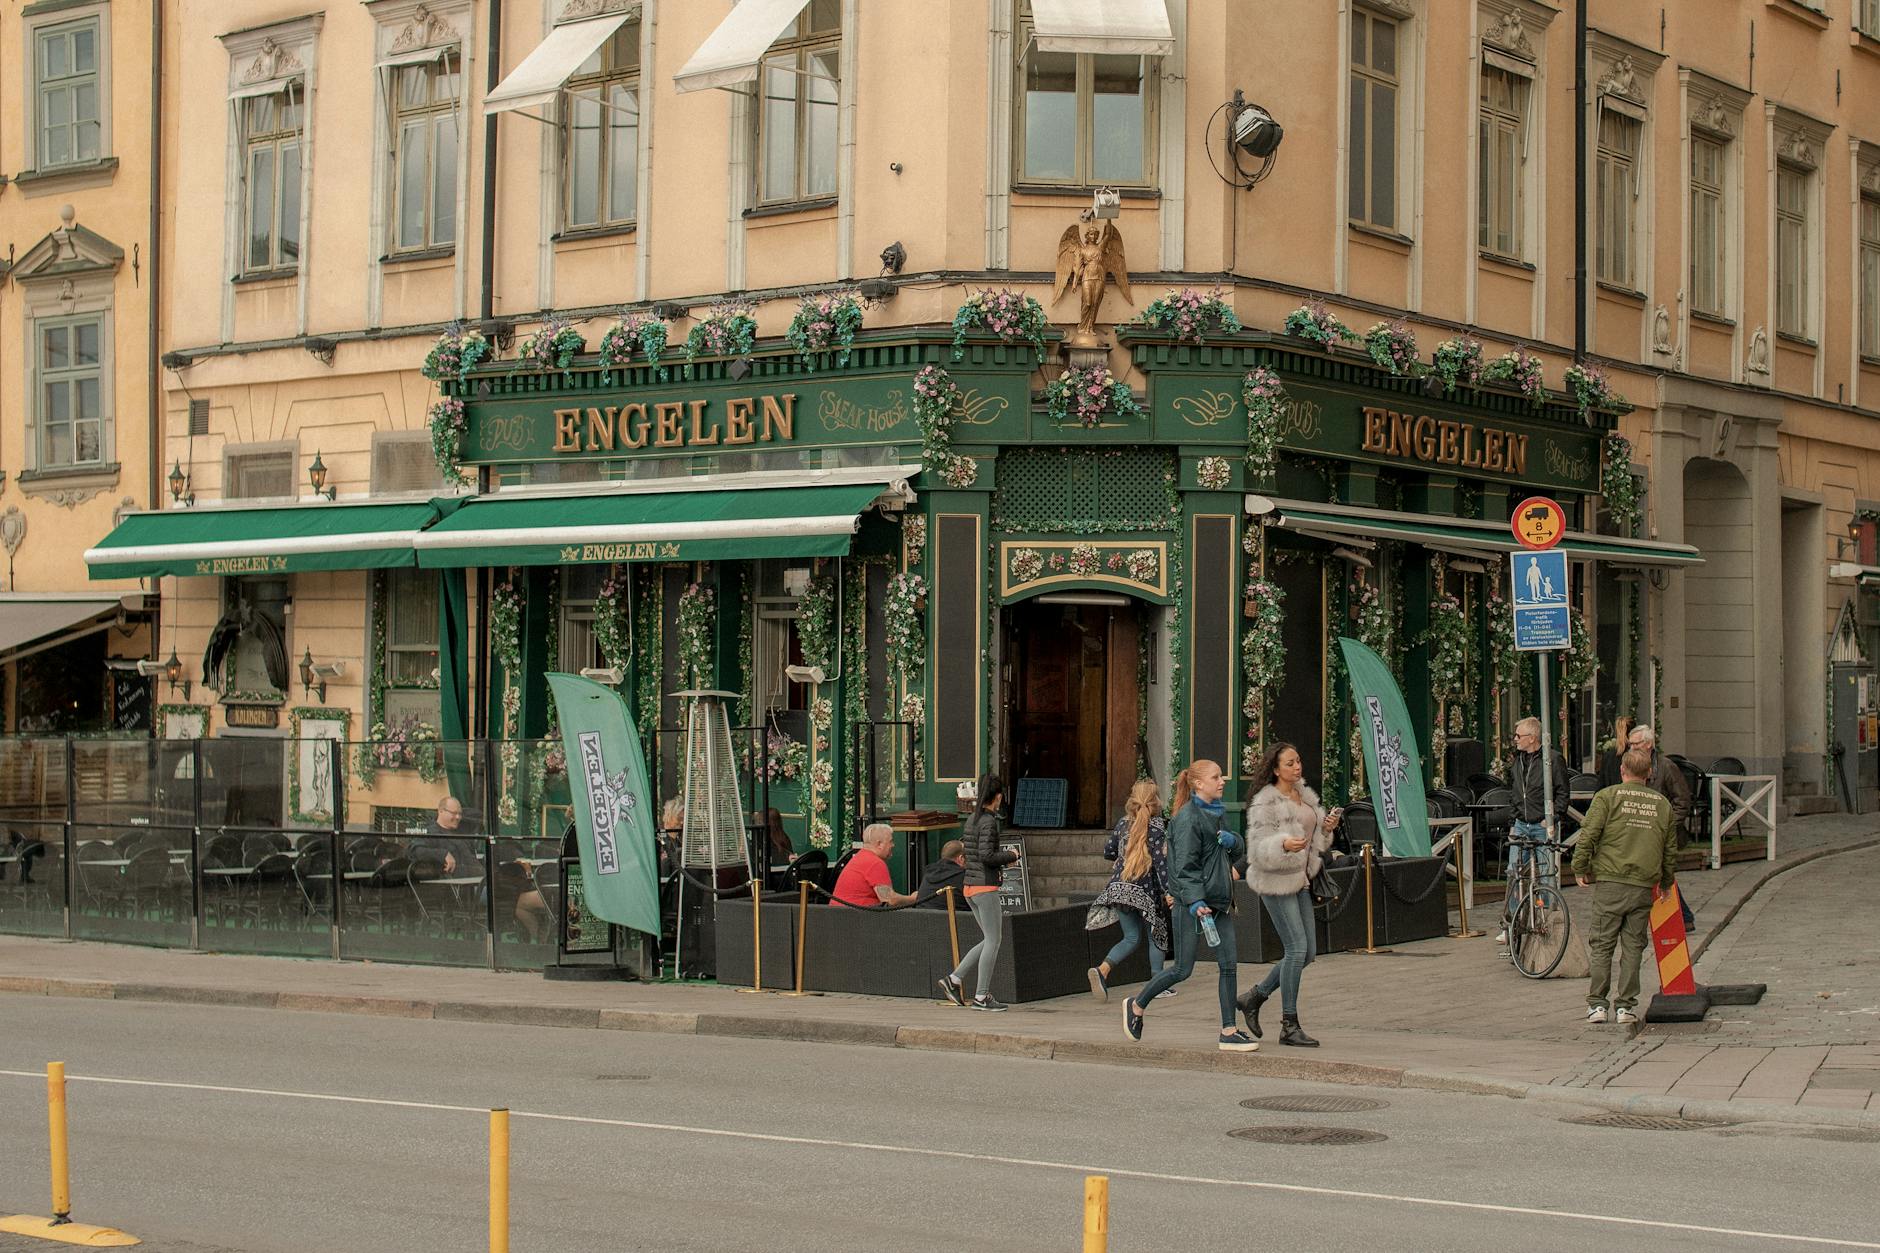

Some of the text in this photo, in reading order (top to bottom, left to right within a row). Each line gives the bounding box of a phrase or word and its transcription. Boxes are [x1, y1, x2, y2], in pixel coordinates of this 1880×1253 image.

[552, 393, 797, 452] ENGELEN
[1280, 399, 1316, 437] PUB
[482, 415, 528, 451] PUB
[1361, 406, 1529, 476] ENGELEN
[1535, 521, 1543, 531] 8
[582, 543, 657, 561] ENGELEN
[213, 556, 269, 574] ENGELEN
[1621, 807, 1658, 817] NEW WAYS
[1623, 800, 1657, 810] EXPLORE
